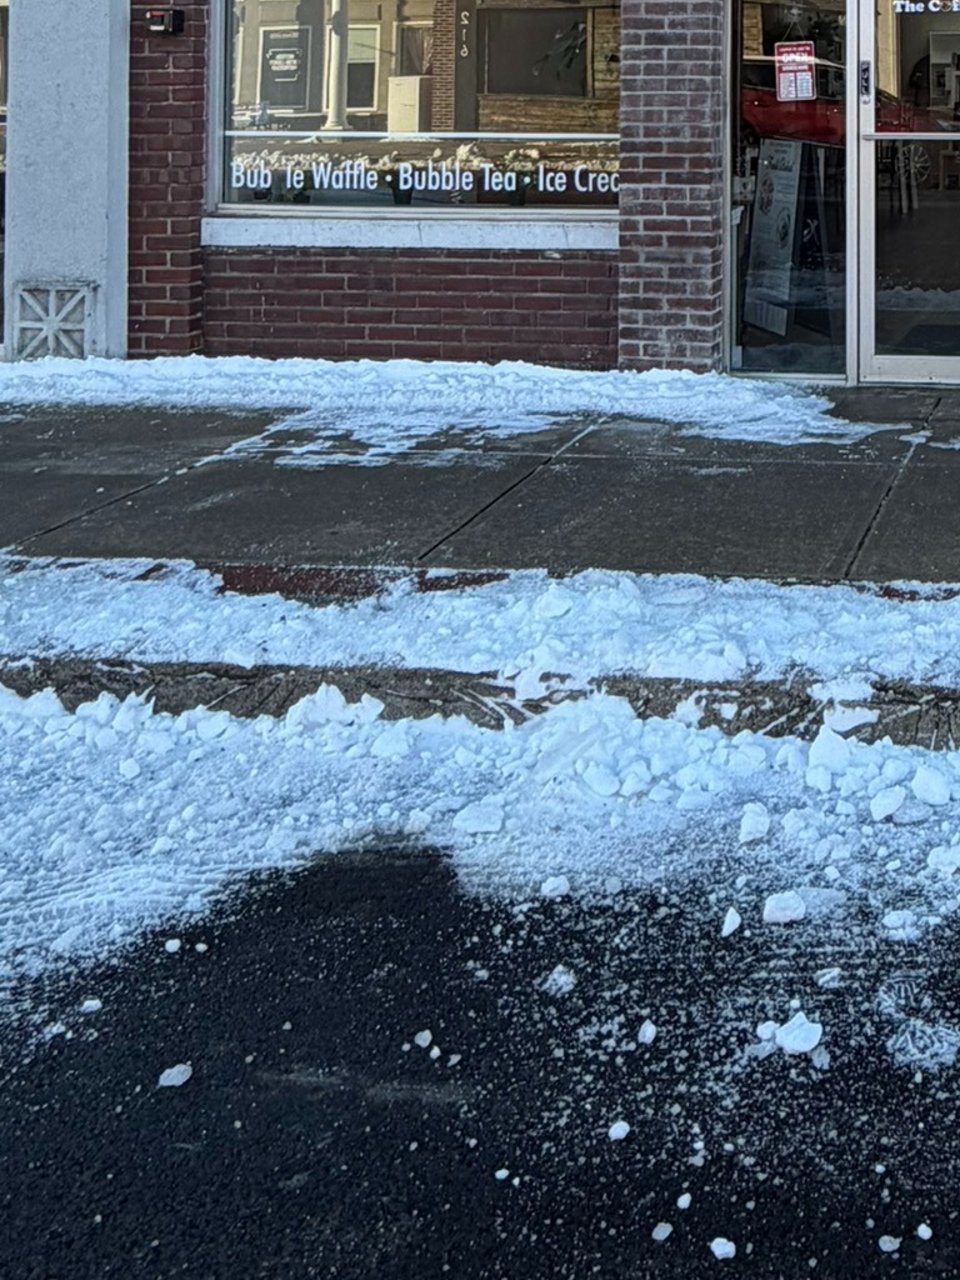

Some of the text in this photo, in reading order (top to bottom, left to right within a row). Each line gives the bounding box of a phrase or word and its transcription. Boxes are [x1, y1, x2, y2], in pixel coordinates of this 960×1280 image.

[892, 0, 925, 12] The
[230, 159, 305, 190] Buble
[311, 160, 379, 191] Waffle
[399, 161, 474, 191] Bubble
[479, 163, 517, 192] Tea
[537, 165, 568, 193] Ice
